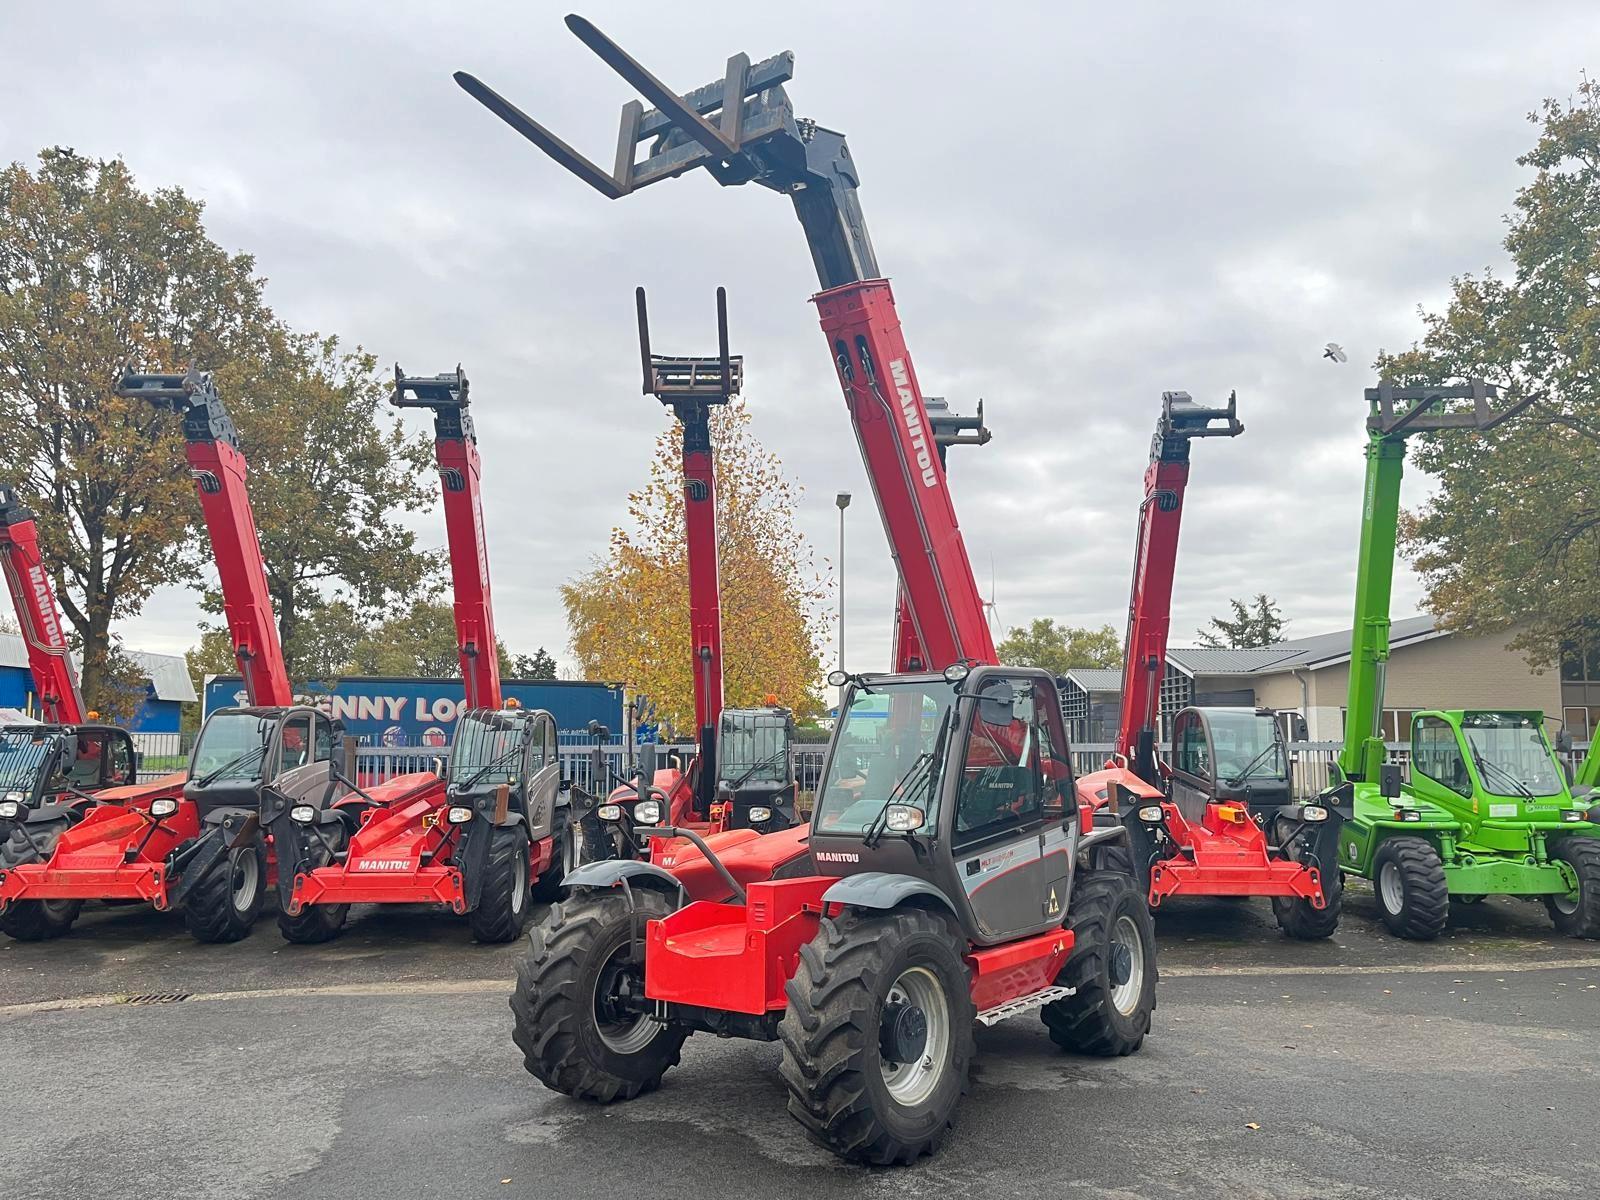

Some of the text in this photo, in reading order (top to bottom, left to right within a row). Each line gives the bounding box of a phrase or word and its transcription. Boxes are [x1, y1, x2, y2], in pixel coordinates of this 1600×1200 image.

[889, 358, 937, 488] MANITOU
[28, 565, 62, 647] MANITOU
[359, 860, 410, 870] MANITOU
[816, 852, 859, 863] MANITOU
